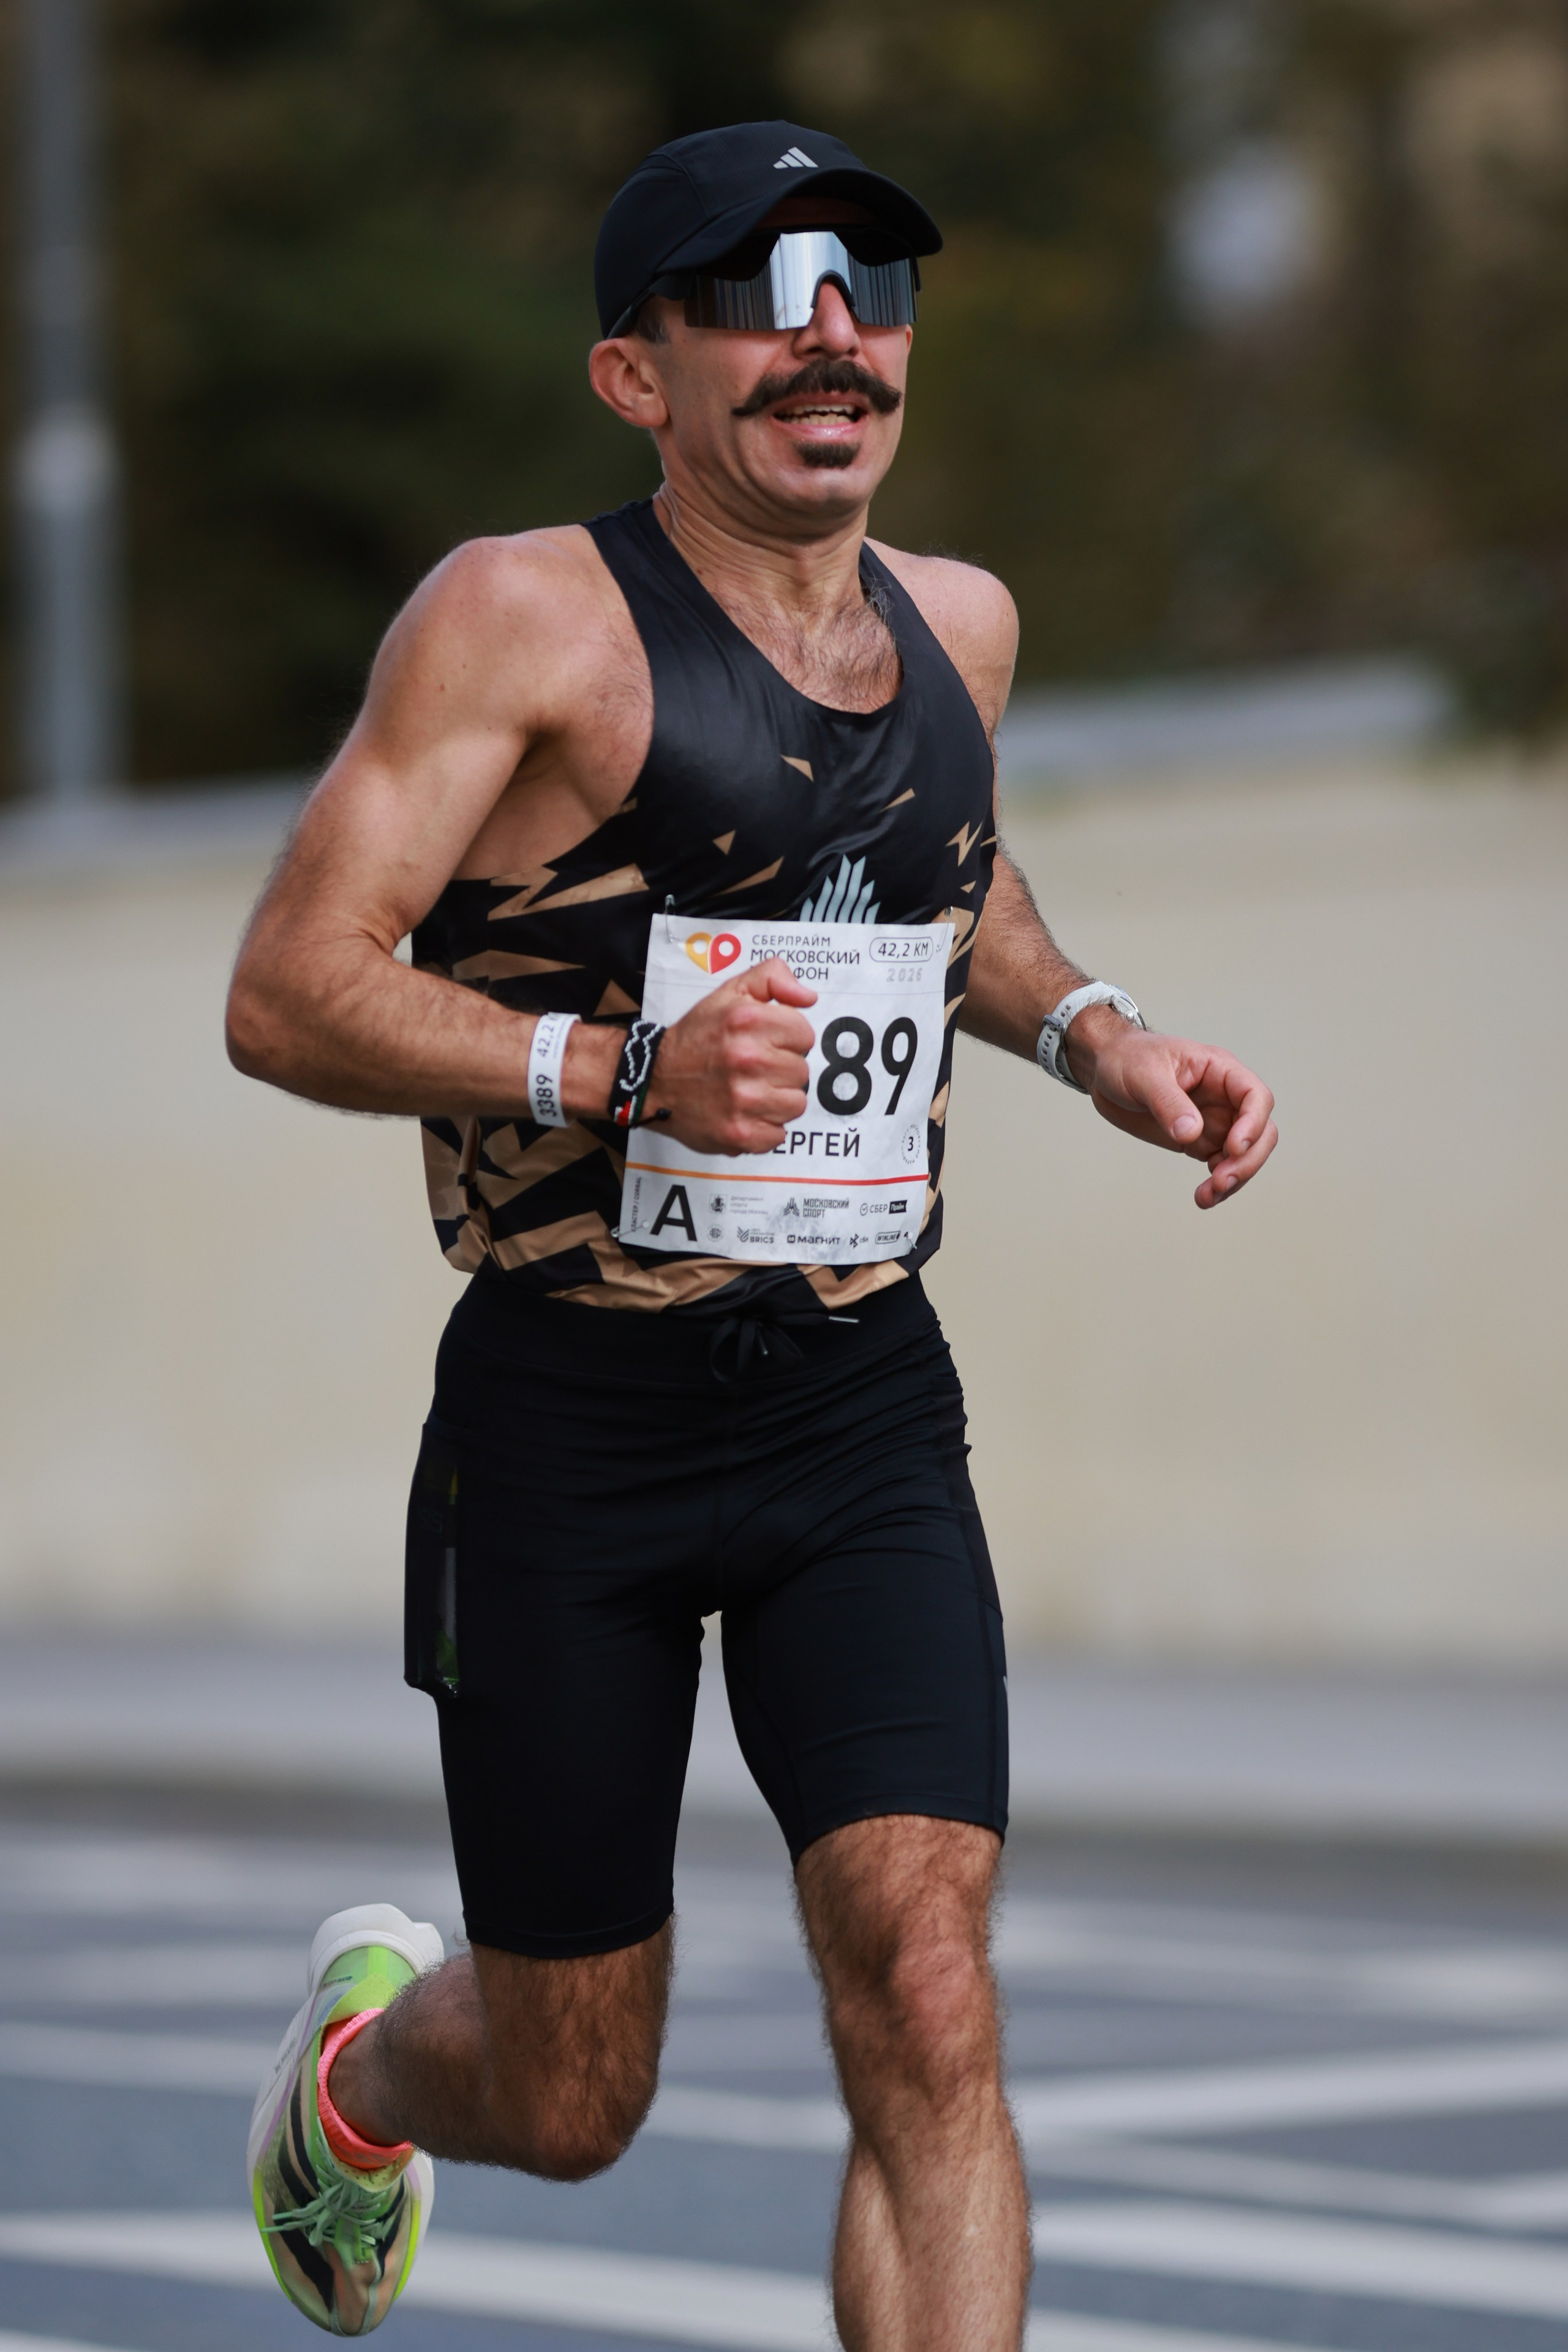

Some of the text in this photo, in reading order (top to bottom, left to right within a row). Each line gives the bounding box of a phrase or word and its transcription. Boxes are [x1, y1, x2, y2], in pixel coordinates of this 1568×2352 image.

[752, 933, 831, 946] СБЕРПРАЙМ
[878, 942, 929, 959] 42,2 КМ
[886, 967, 922, 982] 2026
[802, 1016, 918, 1116] 89
[536, 1074, 557, 1117] 3389
[772, 1128, 861, 1157] РГЕЙ
[907, 1136, 914, 1152] 3
[803, 1197, 850, 1208] МОСКОВСКИЙ
[869, 1204, 888, 1213] СБЕР
[802, 1208, 825, 1218] СПОРТ
